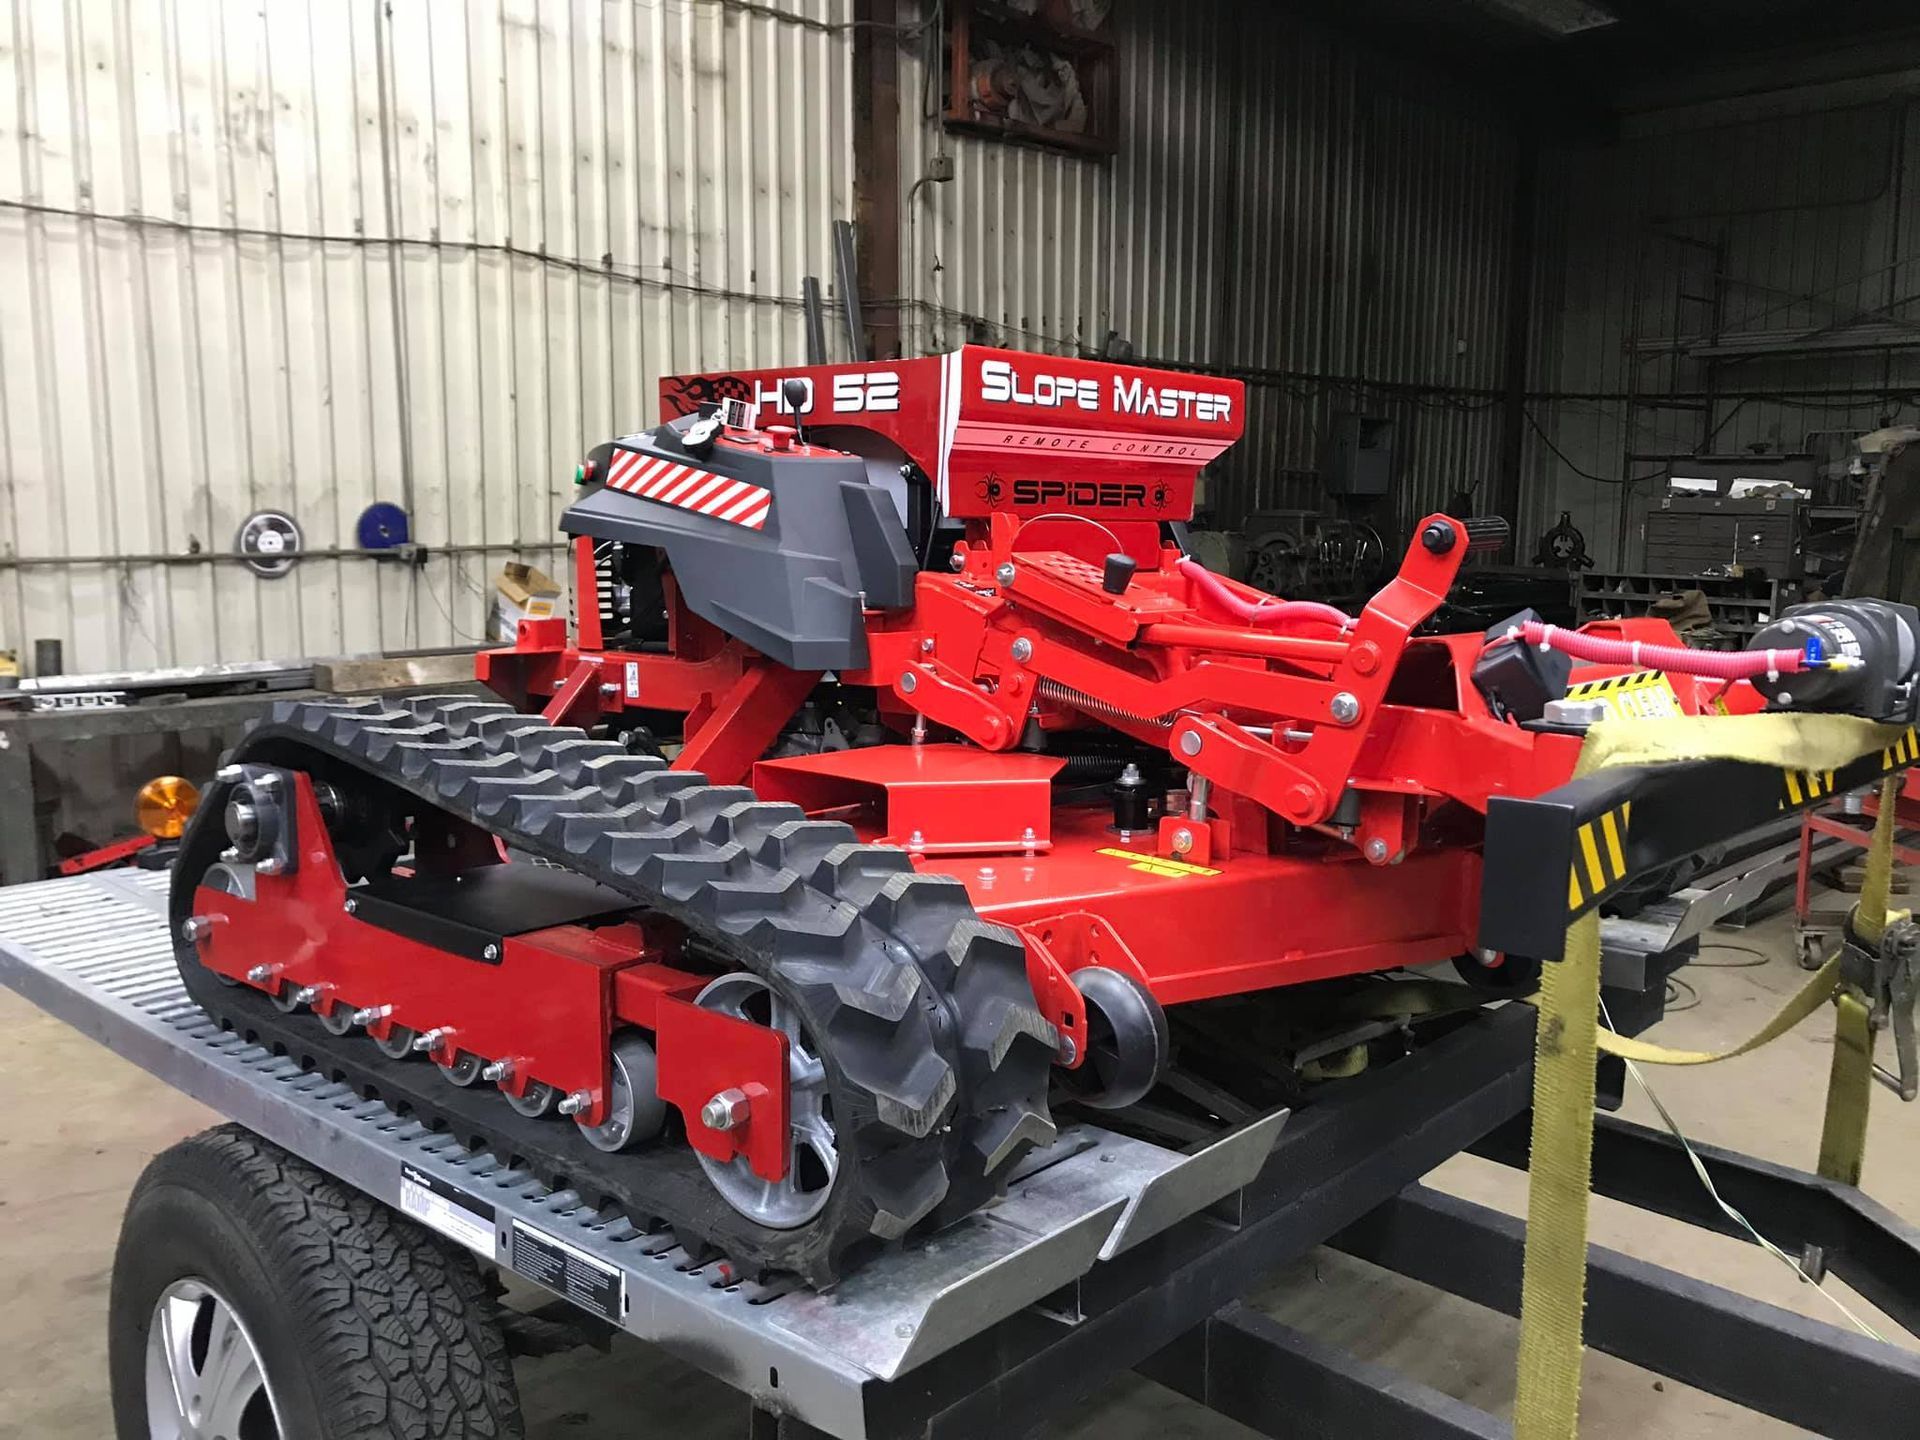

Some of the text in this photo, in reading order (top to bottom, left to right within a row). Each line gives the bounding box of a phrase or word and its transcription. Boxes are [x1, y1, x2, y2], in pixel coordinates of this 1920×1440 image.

[833, 372, 901, 413] 52
[981, 359, 1232, 423] SLOPE MASTER
[1003, 434, 1200, 457] REMOTE CONTROL
